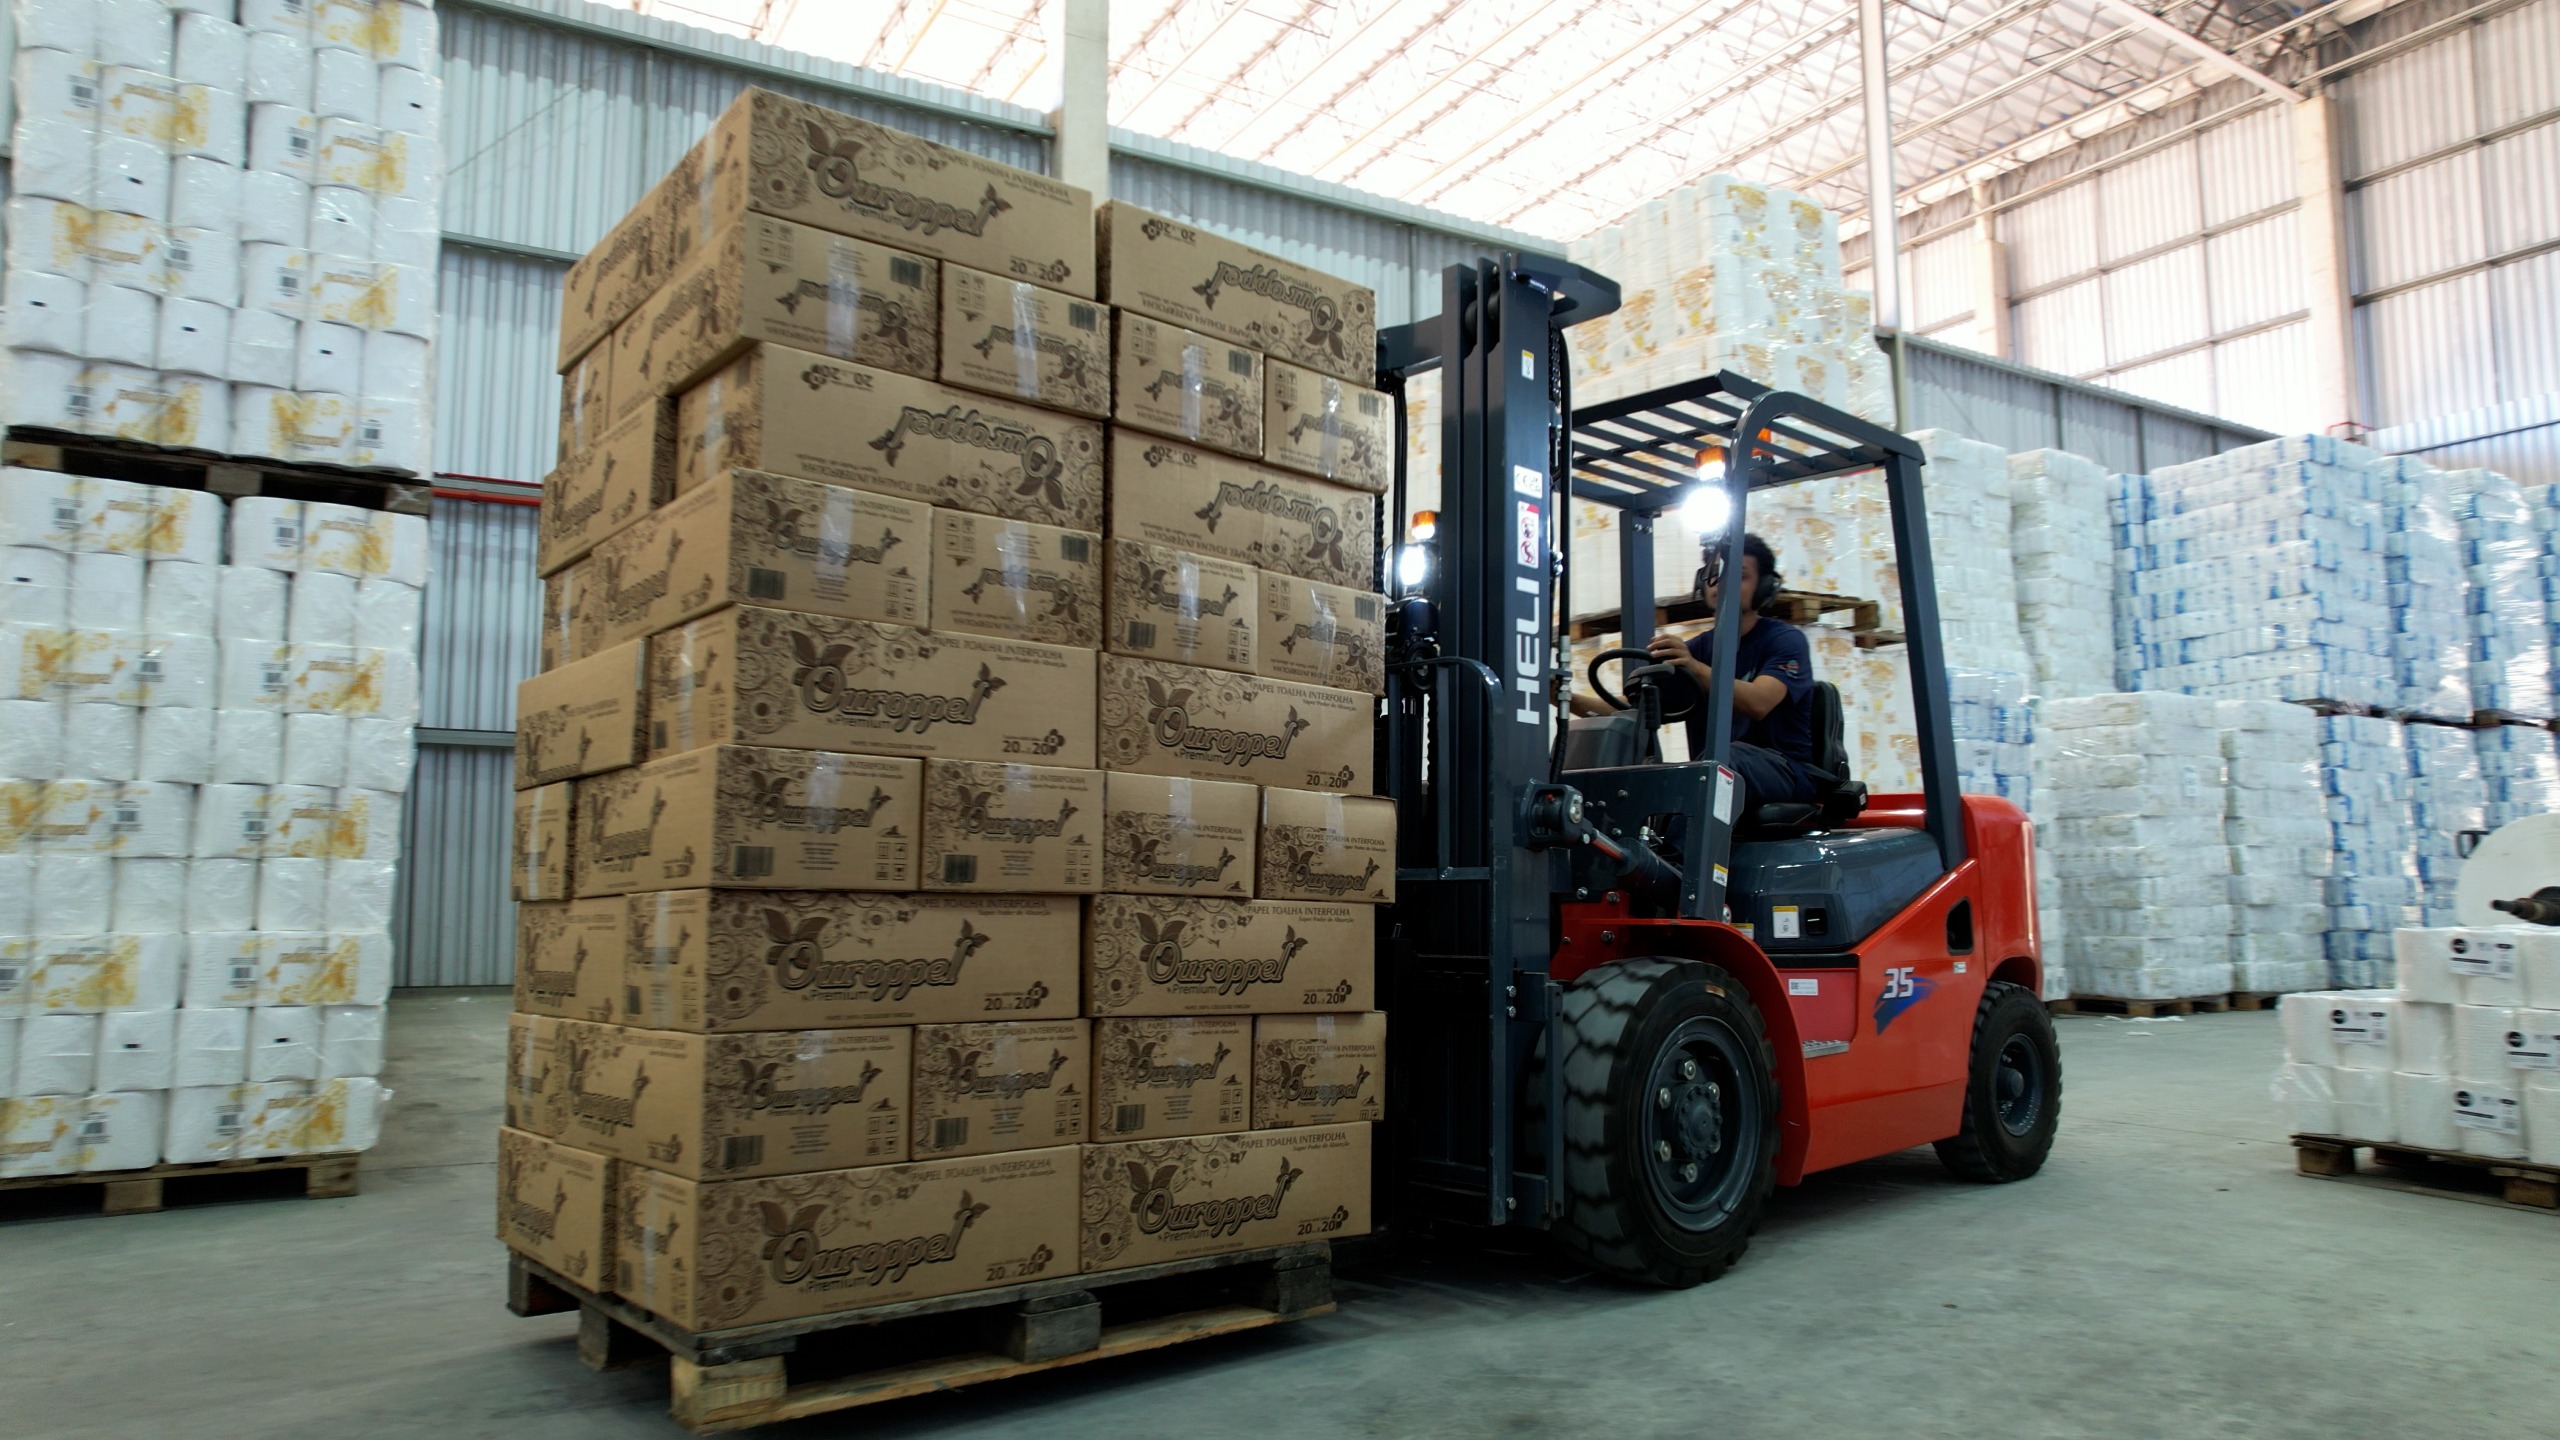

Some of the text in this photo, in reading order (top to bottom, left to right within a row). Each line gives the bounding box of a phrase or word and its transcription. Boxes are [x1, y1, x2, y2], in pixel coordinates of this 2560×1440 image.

[817, 157, 997, 238] Ouroppel
[1182, 226, 1197, 241] 20
[1206, 261, 1336, 331] Ouroppel
[886, 406, 1054, 477] Ouroppel
[1185, 448, 1200, 463] 20
[1208, 481, 1336, 543] Ouroppel
[1516, 576, 1540, 725] HELI
[804, 665, 990, 734] Ouroppel
[1253, 682, 1353, 705] PAPEL TOALHA INTERFOLHA
[1002, 741, 1019, 755] 20
[1156, 706, 1297, 767] Ouroppel
[1179, 749, 1223, 763] Premium
[1306, 774, 1320, 786] 20
[1328, 776, 1341, 788] 20
[967, 805, 1067, 843] Ouroppel
[1200, 825, 1240, 835] INTERFOLHA
[1350, 837, 1387, 846] INTERFOLHA
[1137, 852, 1225, 888] Ouroppel
[1294, 863, 1370, 895] Ouroppel
[1248, 906, 1351, 917] PAPEL TOALHA INTERFOLHA
[777, 939, 971, 1002] Ouroppel
[1149, 940, 1294, 995] Ouroppel
[1883, 967, 1914, 998] 35
[985, 998, 1003, 1011] 20
[1173, 984, 1218, 995] Premium
[1304, 994, 1317, 1006] 20
[1326, 994, 1339, 1005] 20
[957, 1061, 1056, 1100] Ouroppel
[1135, 1054, 1221, 1088] Ouroppel
[751, 1074, 868, 1116] Ouroppel
[1287, 1076, 1361, 1106] Ouroppel
[1240, 1131, 1346, 1149] PAPEL TOALHA INTERFOLHA
[1139, 1173, 1289, 1237] Ouroppel
[1164, 1226, 1211, 1242] Premium
[1298, 1225, 1312, 1238] 20
[1321, 1221, 1334, 1234] 20
[773, 1208, 973, 1287] Ouroppel
[985, 1268, 1004, 1284] 20
